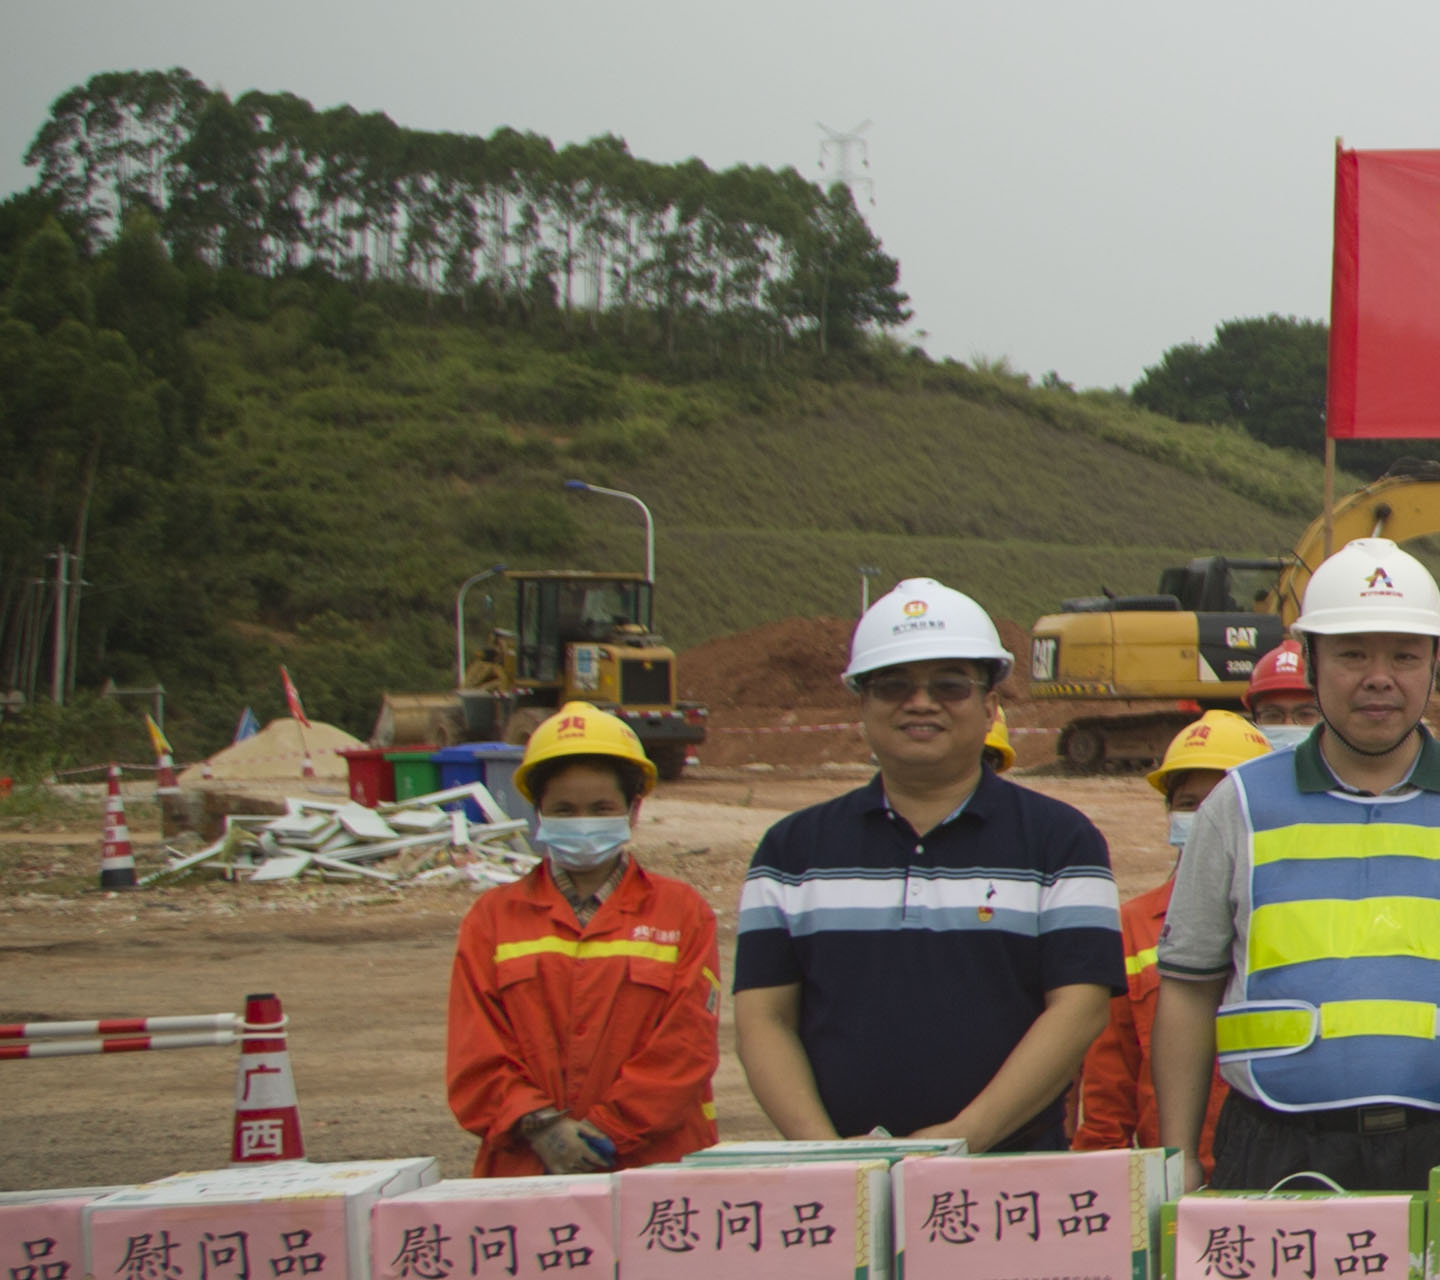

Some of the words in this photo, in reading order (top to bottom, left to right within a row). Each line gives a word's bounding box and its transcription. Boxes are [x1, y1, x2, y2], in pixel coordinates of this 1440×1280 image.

[1032, 638, 1056, 680] CAT
[1225, 626, 1258, 649] CAT
[640, 1197, 835, 1252] 慰问品
[922, 1189, 1110, 1244] 慰问品
[392, 1224, 593, 1280] 慰问品
[1197, 1225, 1388, 1279] 慰问品
